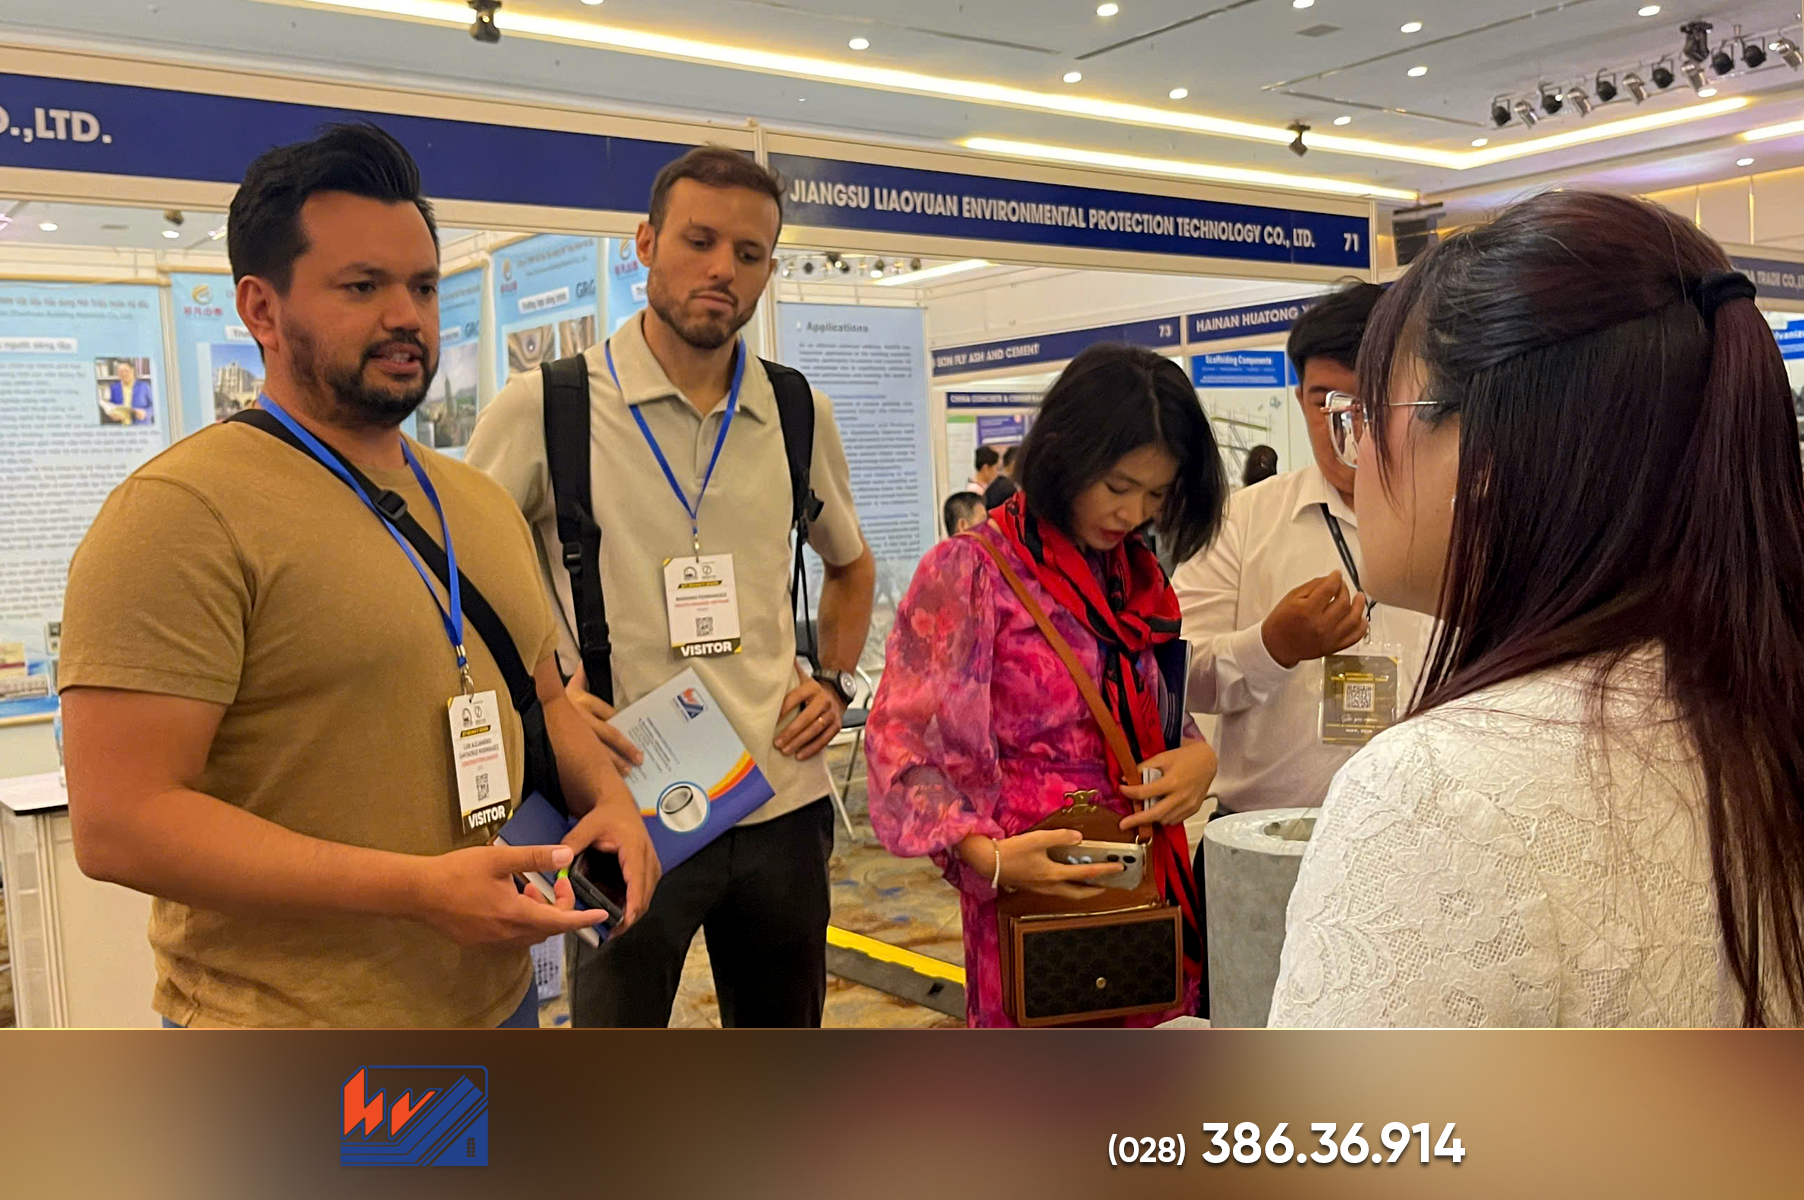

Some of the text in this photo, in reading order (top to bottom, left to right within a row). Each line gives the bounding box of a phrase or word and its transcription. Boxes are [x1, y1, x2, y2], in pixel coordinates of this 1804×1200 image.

[790, 179, 1316, 249] JIANGSU LIAOYUAN ENVIRONMENTAL PROTECTION TECHNOLOGY CO., LTD.
[1343, 233, 1359, 252] 71
[806, 321, 869, 333] Applications
[1196, 315, 1239, 333] HAINAN
[1242, 307, 1298, 326] HUATONG
[1158, 324, 1173, 337] 73
[968, 351, 984, 363] ASH
[986, 348, 1004, 361] AND
[1005, 343, 1040, 359] CEMENT
[1205, 354, 1272, 366] Scaffolding Components
[680, 641, 733, 657] VISITOR
[468, 804, 506, 829] VISITOR
